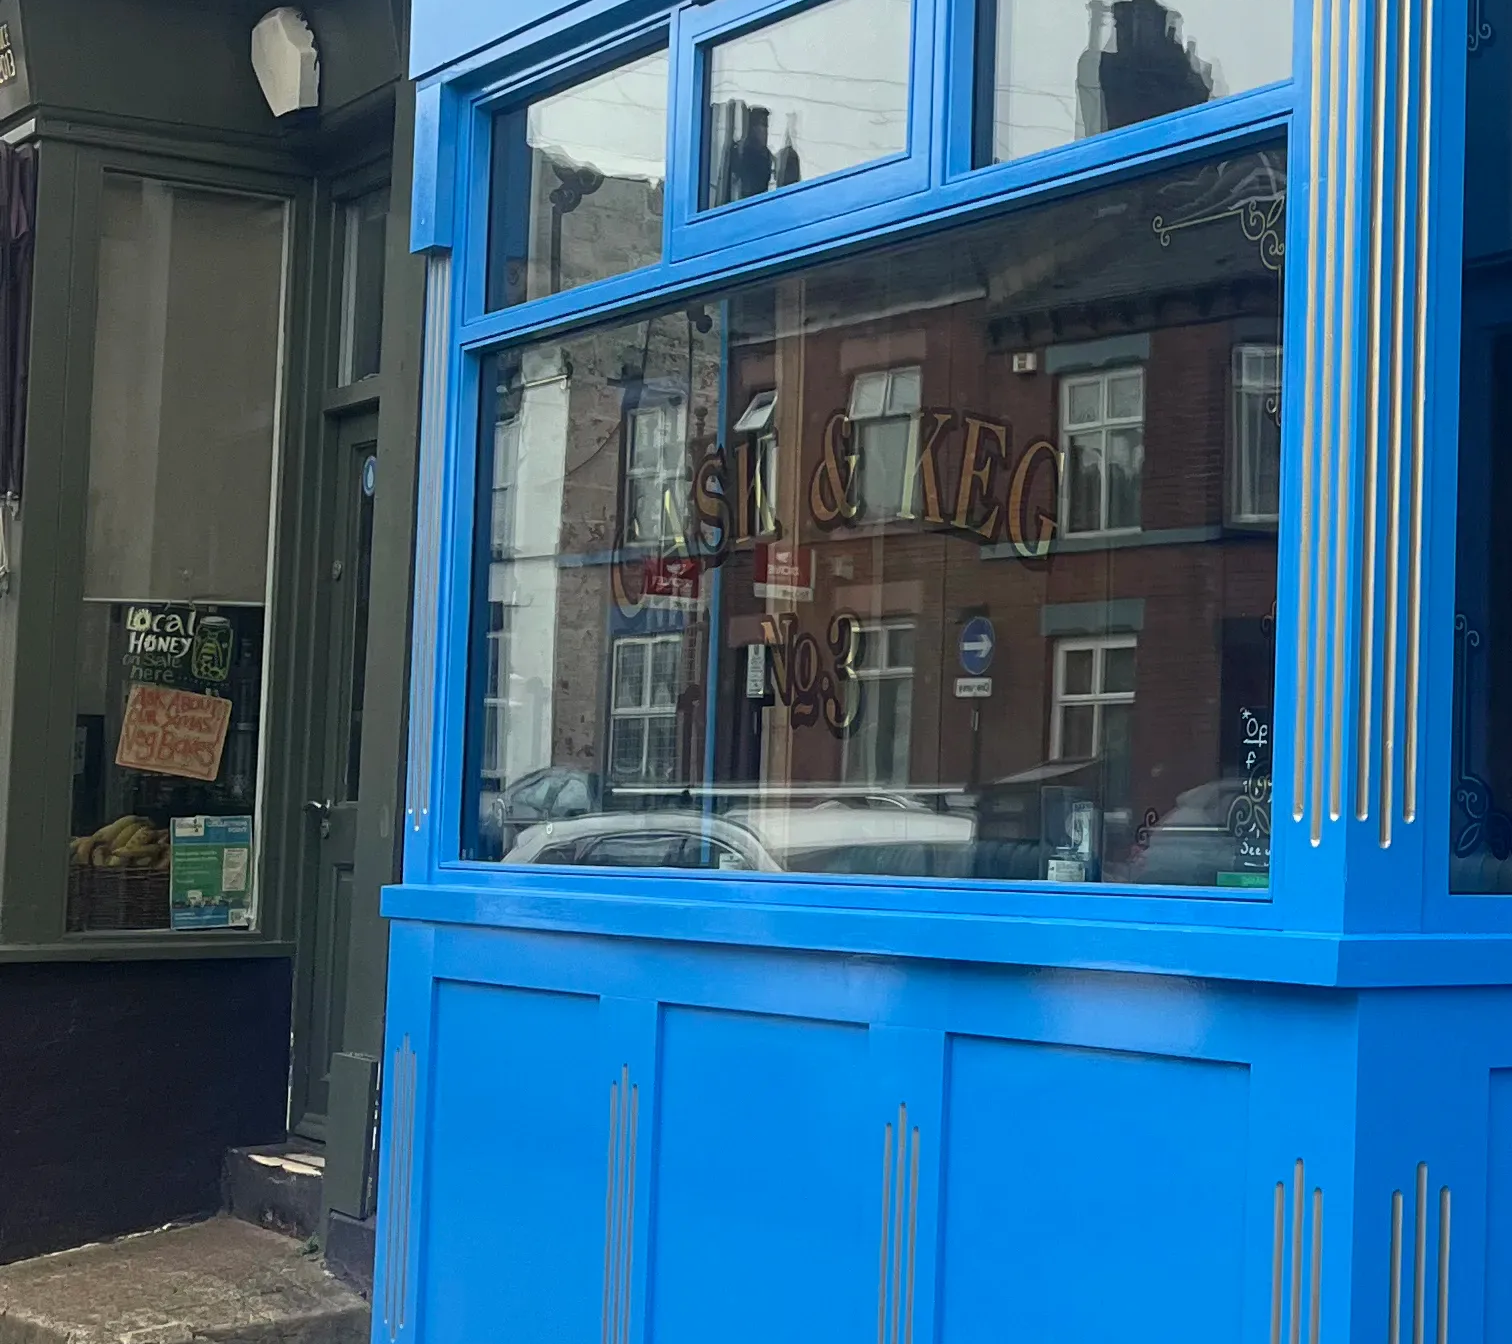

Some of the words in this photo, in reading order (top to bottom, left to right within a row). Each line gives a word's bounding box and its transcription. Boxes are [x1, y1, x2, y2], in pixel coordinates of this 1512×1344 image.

[811, 413, 858, 522] &
[896, 411, 1065, 558] KEG
[128, 631, 193, 659] HONEY
